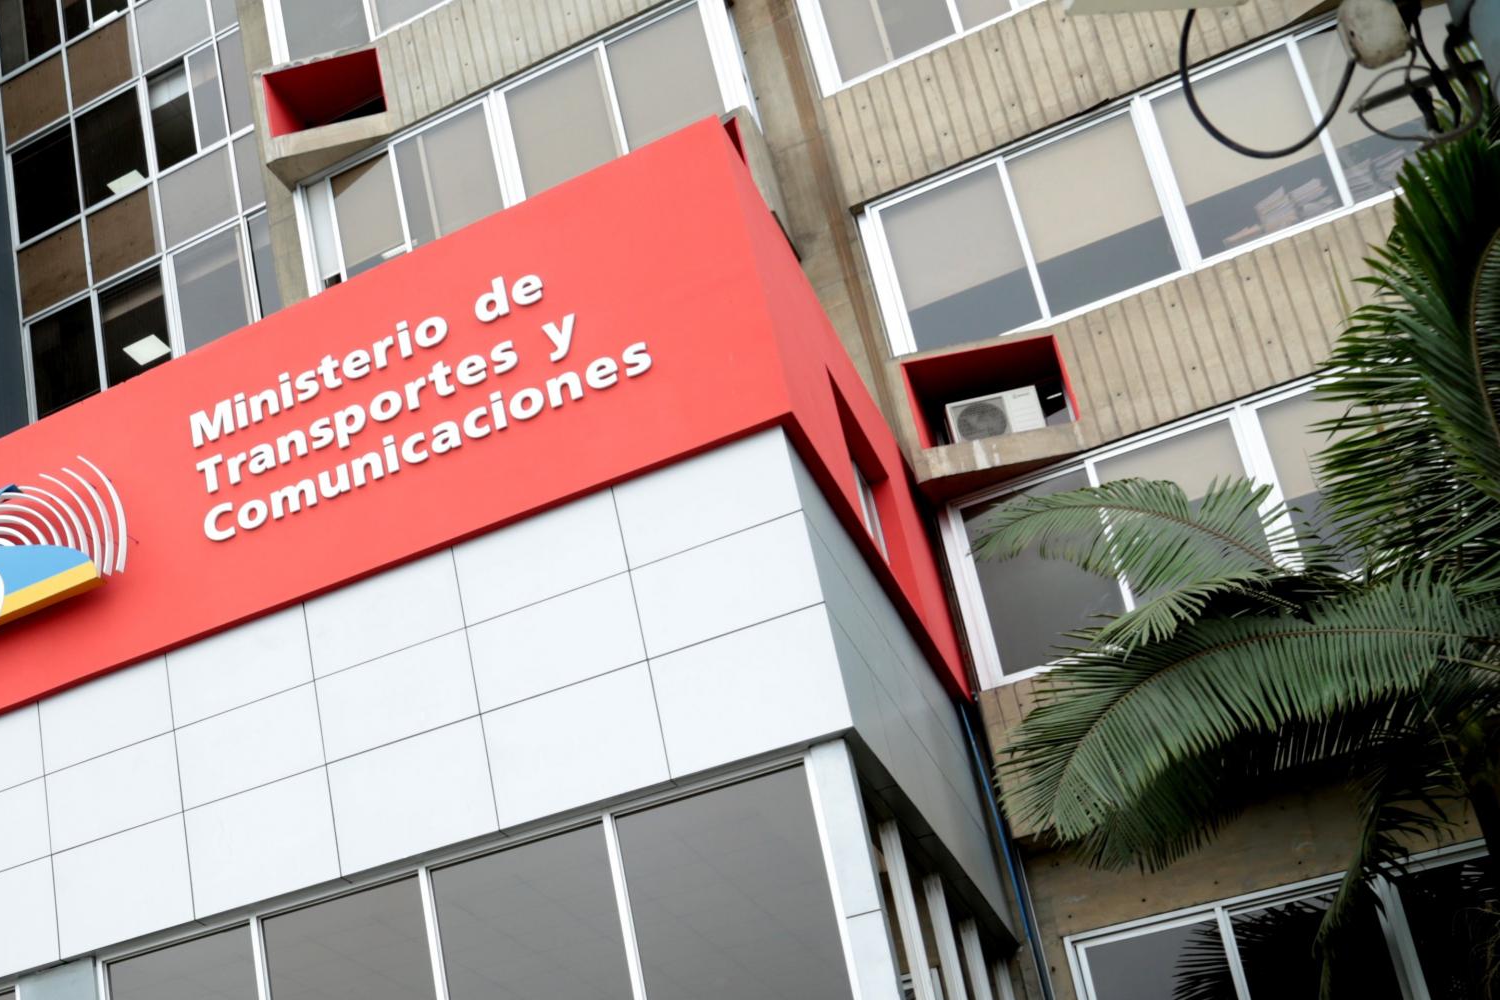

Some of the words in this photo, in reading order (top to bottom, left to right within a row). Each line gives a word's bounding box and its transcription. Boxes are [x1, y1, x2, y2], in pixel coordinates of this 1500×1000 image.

[189, 315, 449, 449] Ministerio
[474, 274, 545, 323] de
[196, 340, 519, 494] Transportes
[541, 313, 577, 362] y
[202, 341, 654, 542] Comunicaciones
